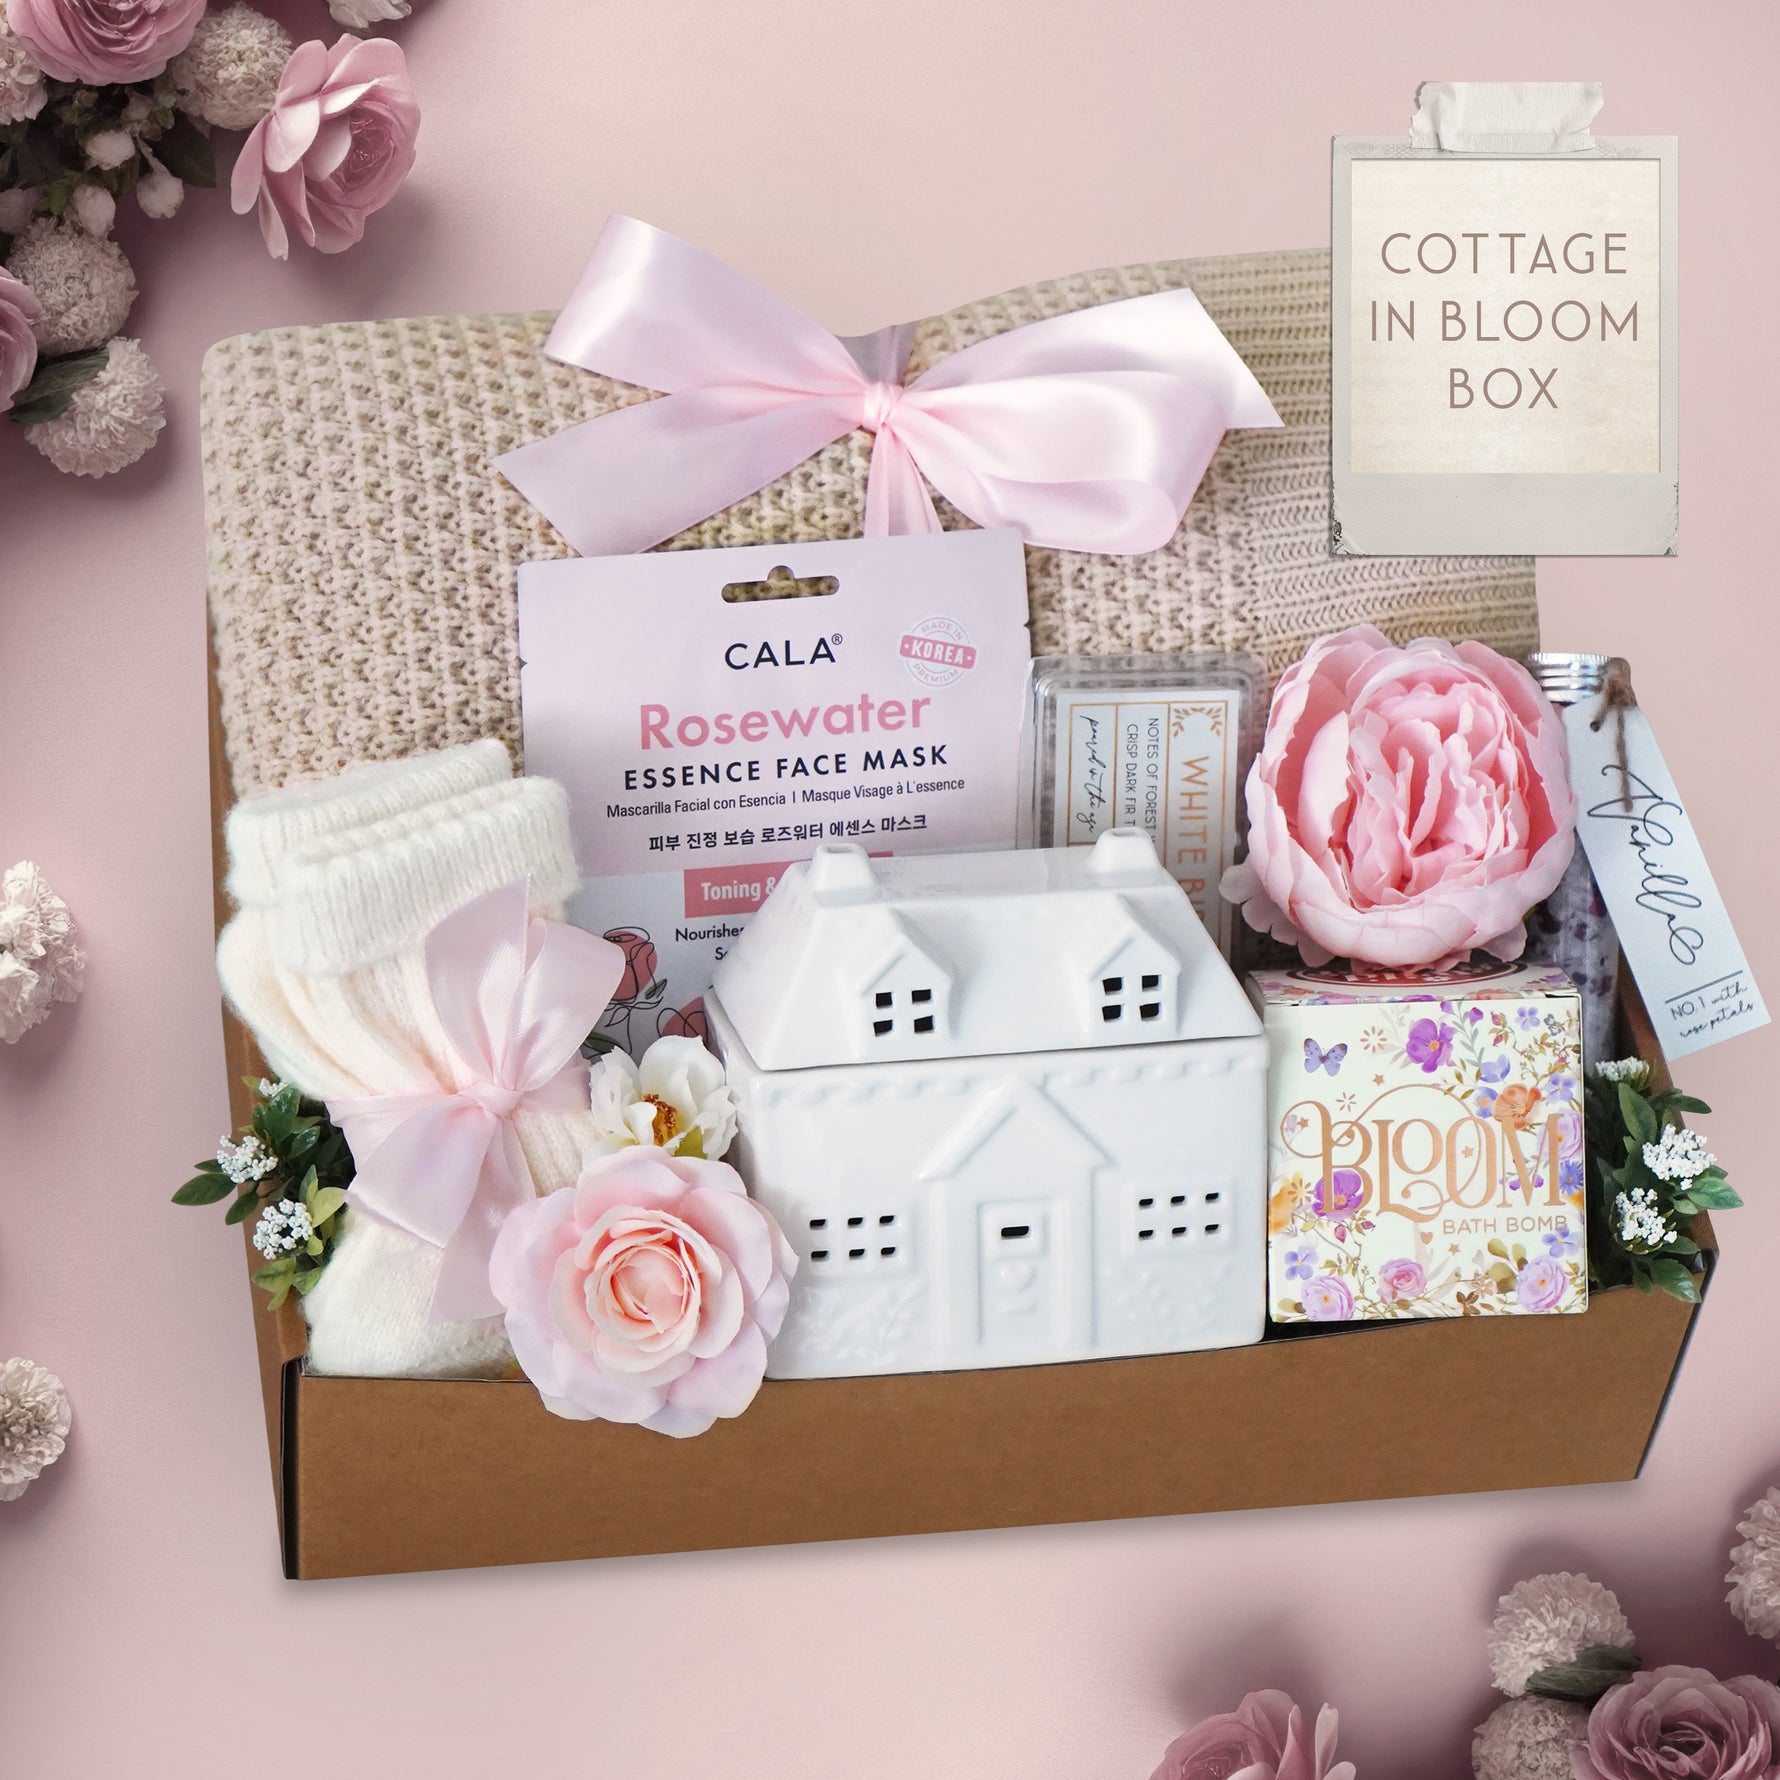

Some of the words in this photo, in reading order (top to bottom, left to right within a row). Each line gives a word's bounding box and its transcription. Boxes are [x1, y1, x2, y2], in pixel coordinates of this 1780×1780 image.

[920, 621, 953, 635] MADE
[953, 628, 964, 641] IN
[911, 639, 965, 665] KOREA
[913, 663, 960, 683] PREMIUM
[640, 693, 931, 750] Rosewater
[1125, 723, 1139, 759] CRISP
[1146, 718, 1160, 760] NOTES
[624, 760, 761, 791] ESSENCE
[776, 753, 848, 779] FACE
[862, 744, 948, 772] MASK
[1124, 762, 1138, 794] DARK
[1145, 763, 1159, 781] OF
[607, 800, 672, 818] Mascarilla
[674, 798, 711, 813] Facial
[713, 798, 736, 810] con
[739, 792, 786, 808] Esencia
[802, 788, 851, 804] Masque
[853, 784, 894, 800] Visage
[896, 782, 904, 795] à
[906, 778, 966, 794] L'essence
[1124, 797, 1137, 815] FIR
[1144, 785, 1158, 831] FOREST
[1177, 756, 1210, 864] WHITE
[649, 835, 681, 852] 피부
[686, 832, 718, 849] 진정
[723, 829, 756, 846] 보습
[760, 823, 824, 843] 로즈워터
[829, 818, 876, 837] 에센스
[881, 814, 928, 832] 마스크
[1587, 764, 1704, 966] Vanilla
[700, 880, 761, 902] Toning
[714, 946, 729, 961] S
[1711, 981, 1748, 1005] with
[1710, 1000, 1754, 1030] petals
[1281, 1083, 1567, 1224] BLOOM
[1442, 1218, 1498, 1235] BATH
[1506, 1215, 1569, 1233] BOMB
